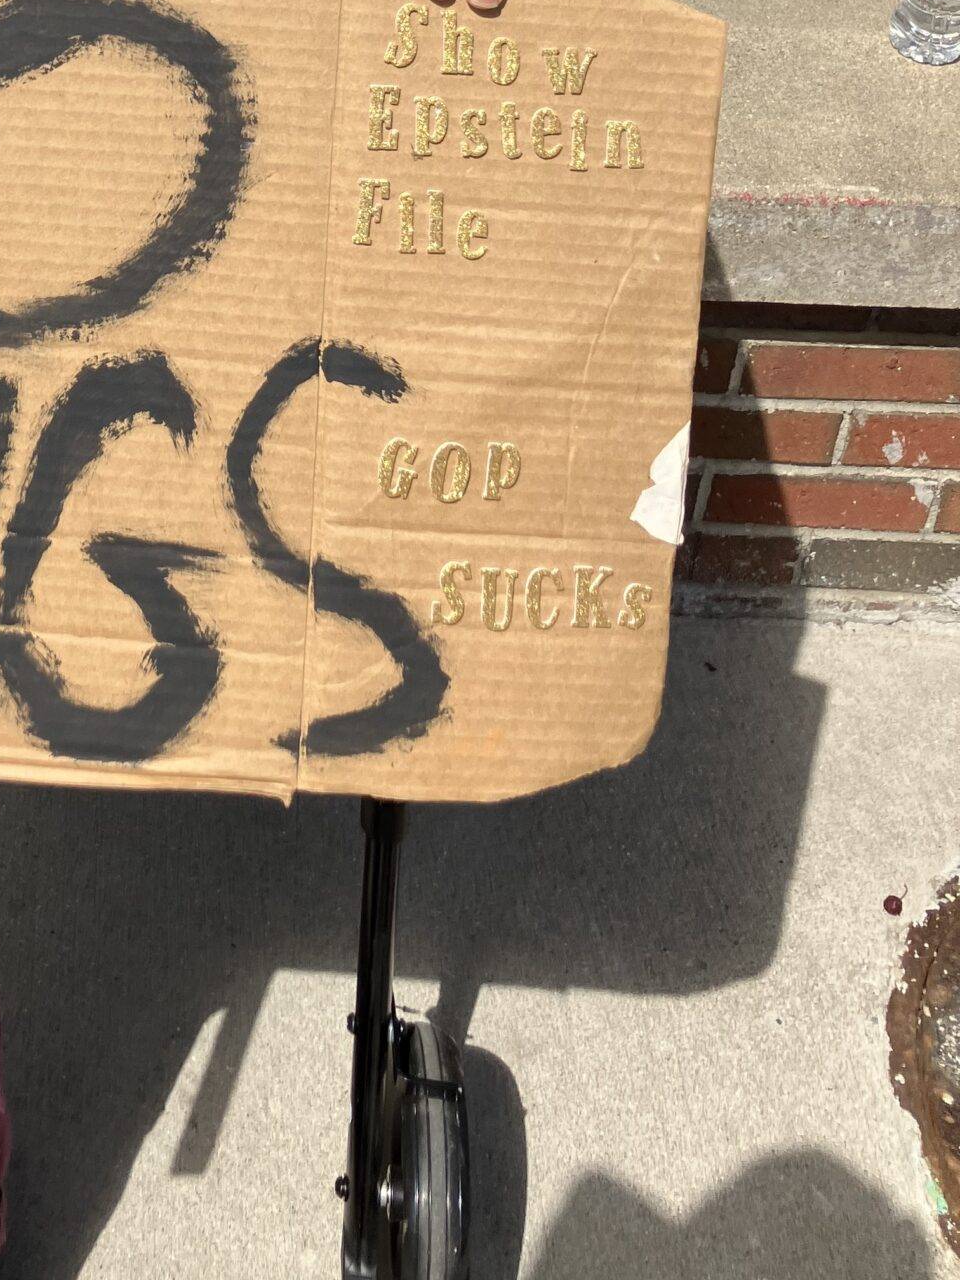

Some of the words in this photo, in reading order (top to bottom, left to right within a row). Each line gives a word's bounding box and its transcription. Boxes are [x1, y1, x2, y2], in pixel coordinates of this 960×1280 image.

[383, 2, 598, 96] Show
[366, 83, 645, 172] Epstein
[351, 177, 490, 261] File
